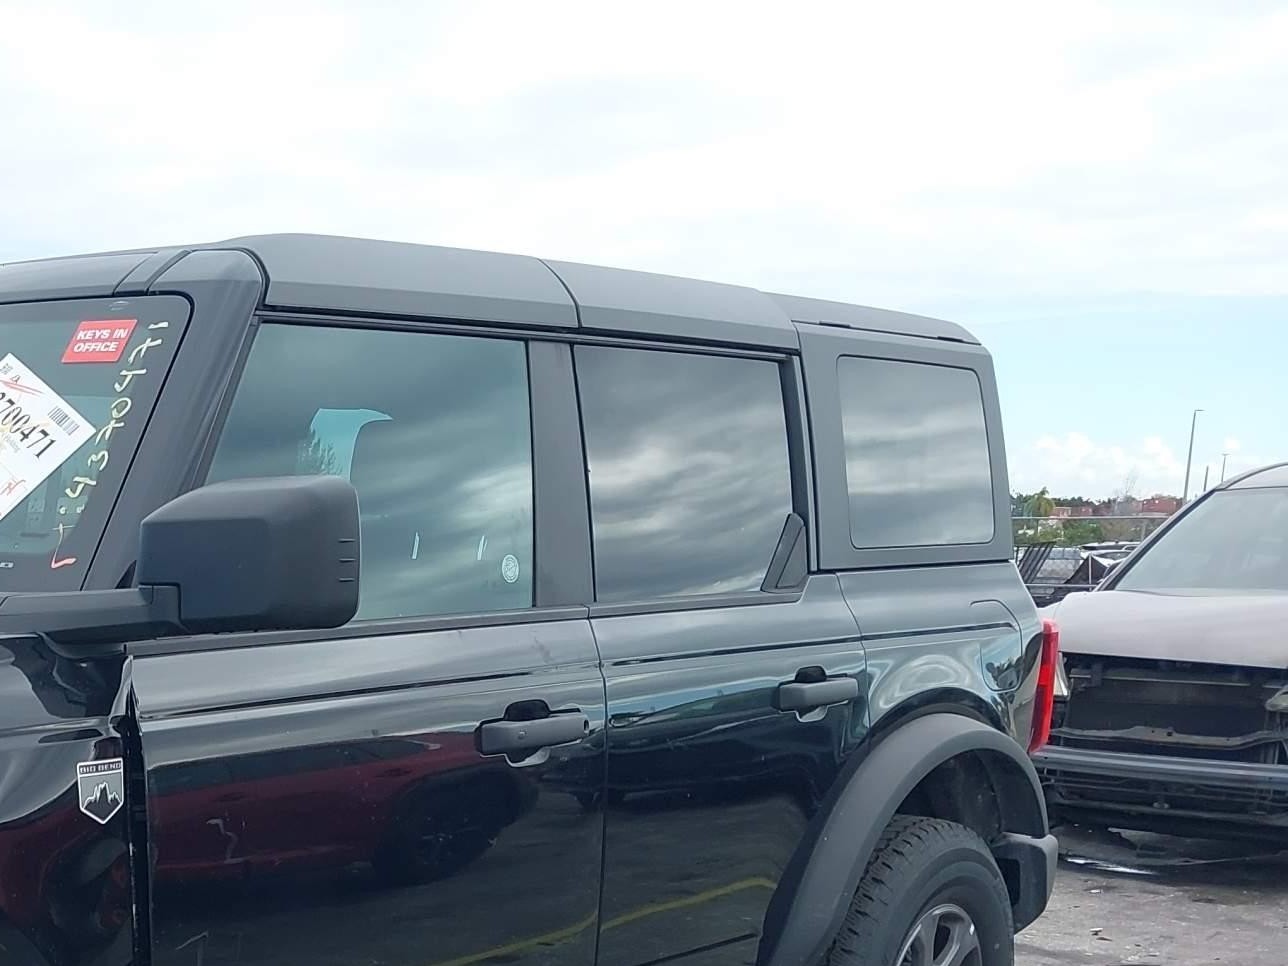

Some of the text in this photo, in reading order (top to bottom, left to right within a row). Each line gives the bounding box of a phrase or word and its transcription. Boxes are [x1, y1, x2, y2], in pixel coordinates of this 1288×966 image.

[77, 328, 129, 340] KEYS IN
[73, 341, 119, 352] OFFICE
